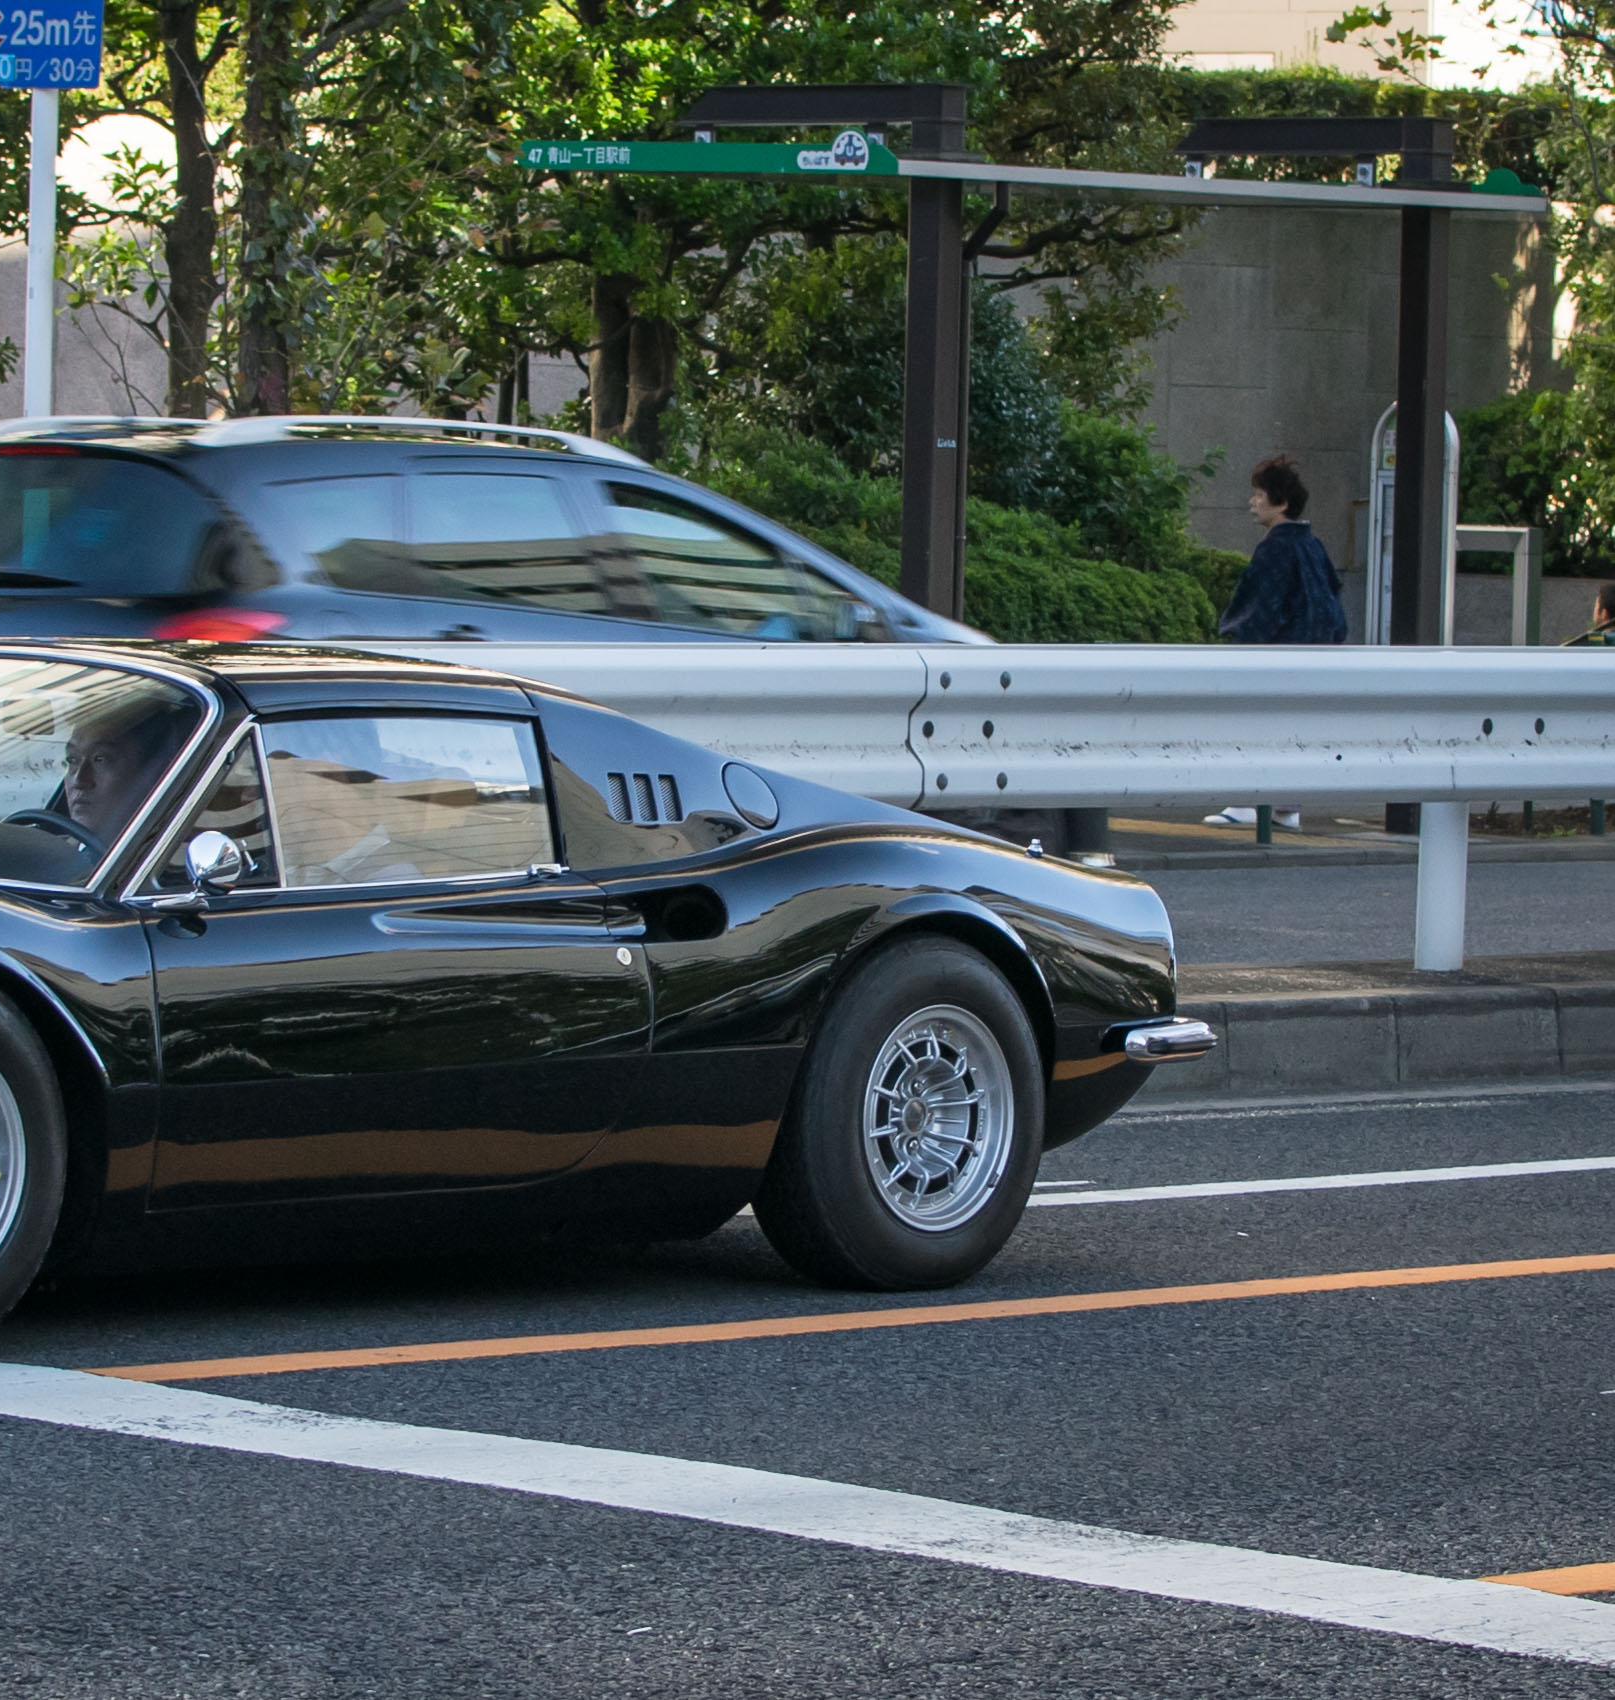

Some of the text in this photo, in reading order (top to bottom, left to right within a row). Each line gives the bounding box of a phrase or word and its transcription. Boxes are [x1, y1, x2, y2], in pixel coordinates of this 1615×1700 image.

[10, 9, 96, 46] 25m先
[528, 146, 631, 165] 47 青山一丁目駅前
